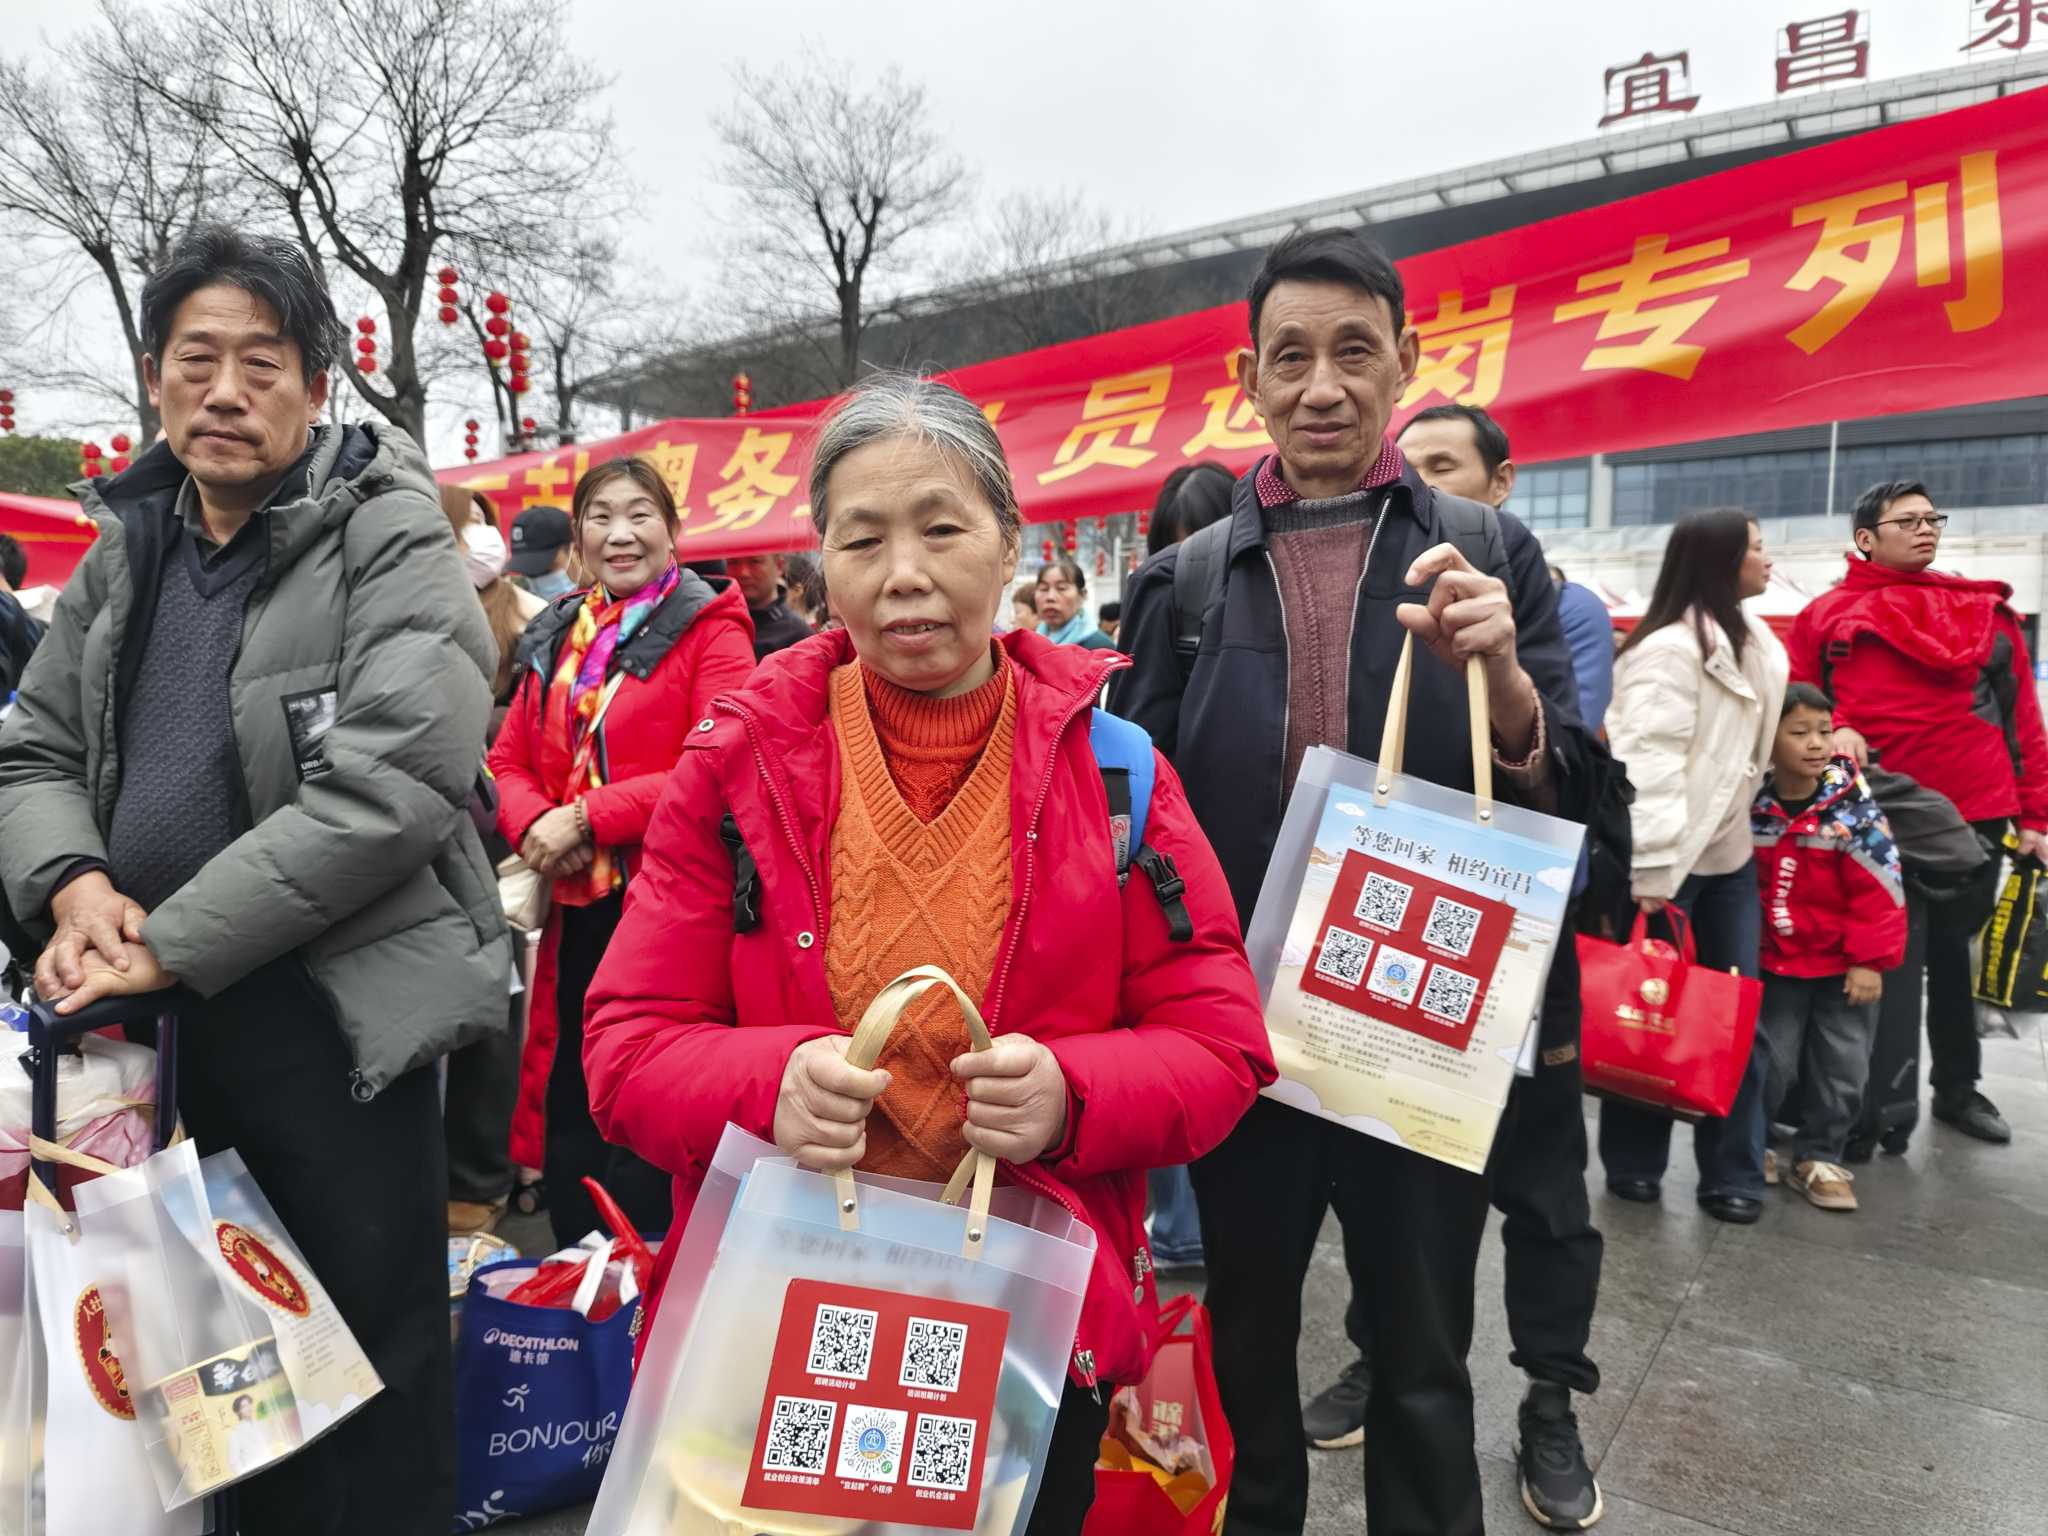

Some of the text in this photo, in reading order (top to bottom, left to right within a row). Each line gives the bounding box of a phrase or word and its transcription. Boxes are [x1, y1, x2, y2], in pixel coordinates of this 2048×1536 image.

[1447, 852, 1532, 895] 相约宜昌
[500, 1332, 579, 1351] DECATHLON
[509, 1349, 550, 1365] 迪卡侬
[488, 1411, 618, 1456] BONJOUR
